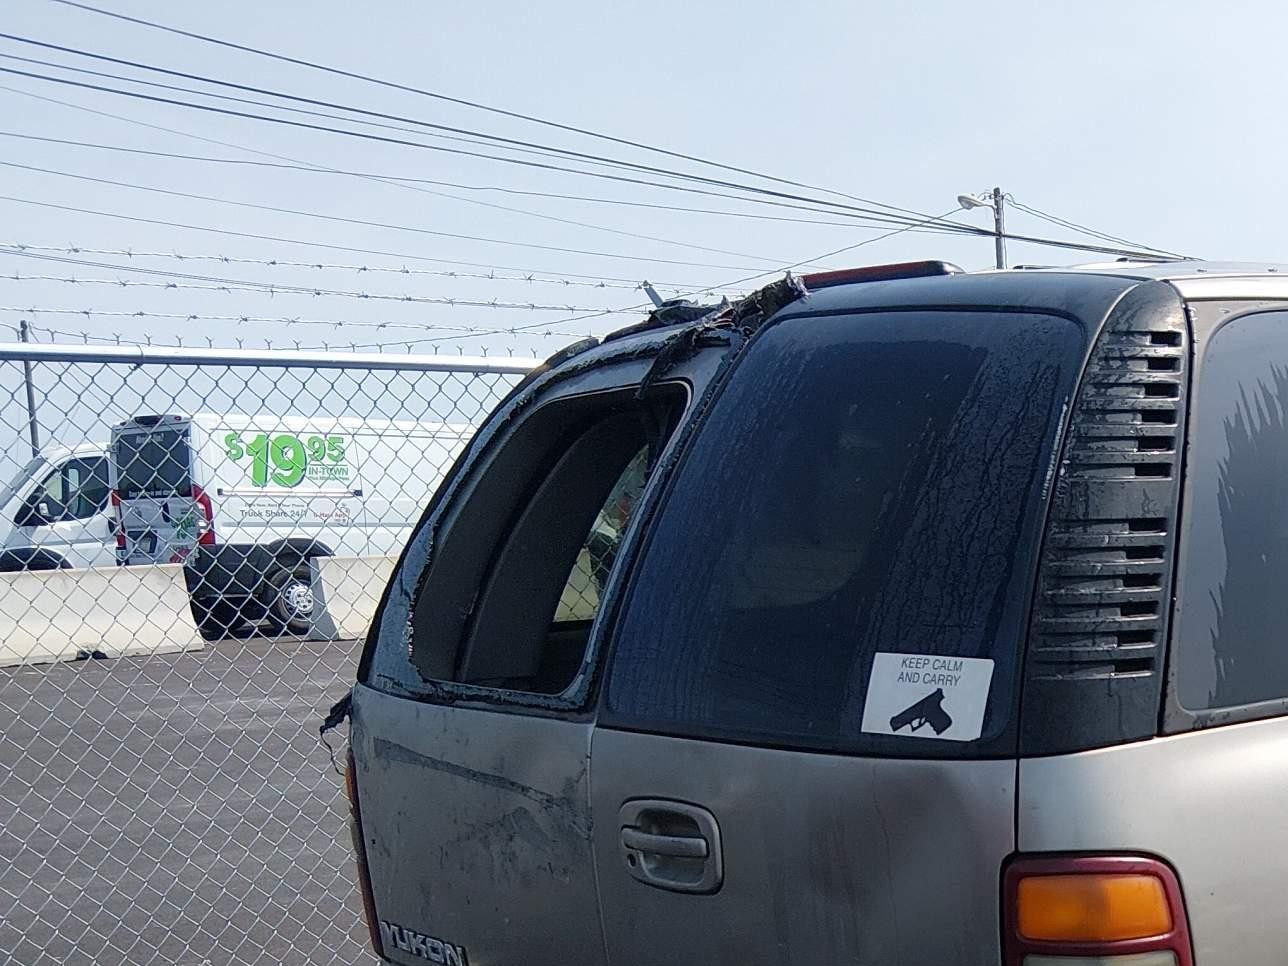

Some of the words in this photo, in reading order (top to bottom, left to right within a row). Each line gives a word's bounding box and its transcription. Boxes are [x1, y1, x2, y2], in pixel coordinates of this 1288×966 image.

[901, 657, 930, 670] KEEP
[932, 658, 963, 672] CALM
[897, 672, 921, 683] AND
[922, 672, 961, 686] CARRY
